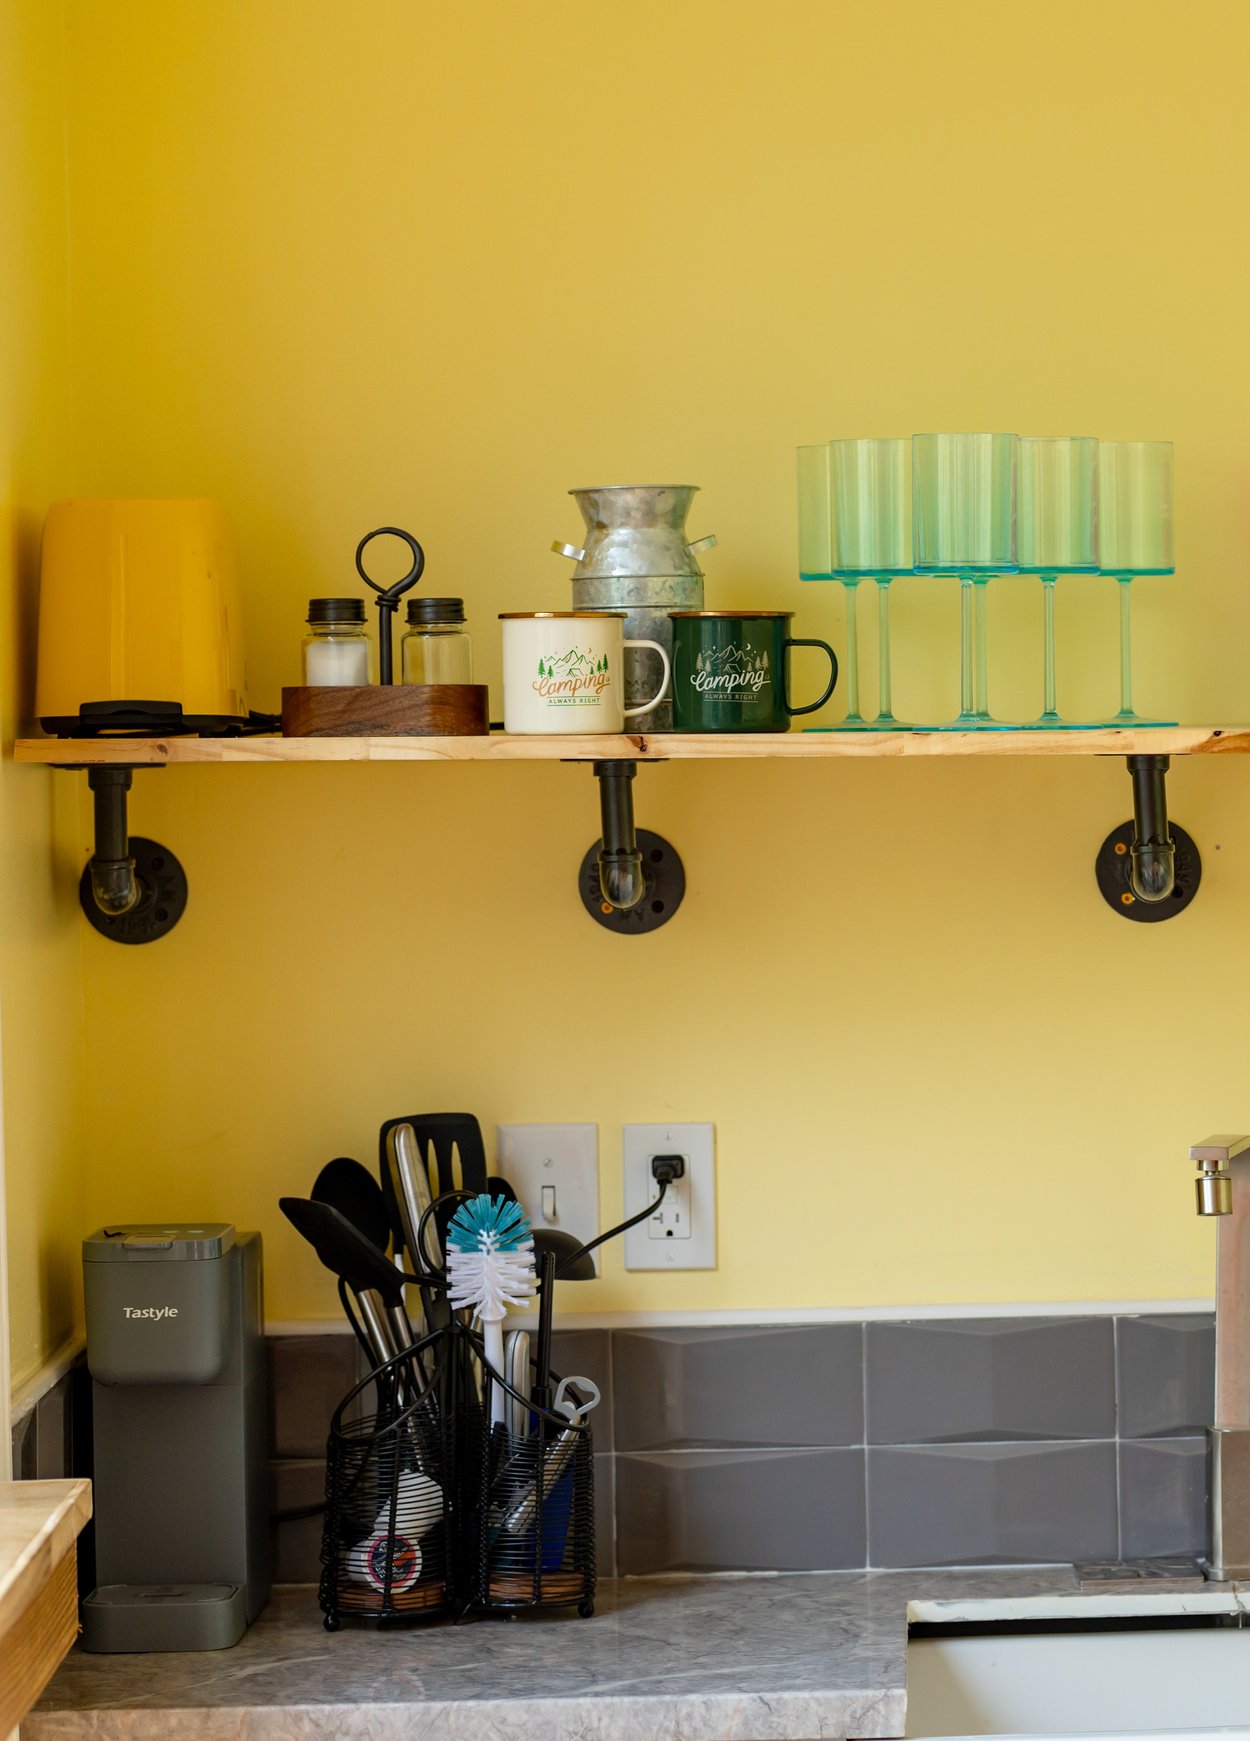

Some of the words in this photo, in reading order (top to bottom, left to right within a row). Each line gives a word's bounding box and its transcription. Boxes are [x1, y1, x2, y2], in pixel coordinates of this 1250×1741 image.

[532, 673, 611, 697] Camping
[690, 669, 772, 693] Camping
[122, 1306, 179, 1321] Tastyle
